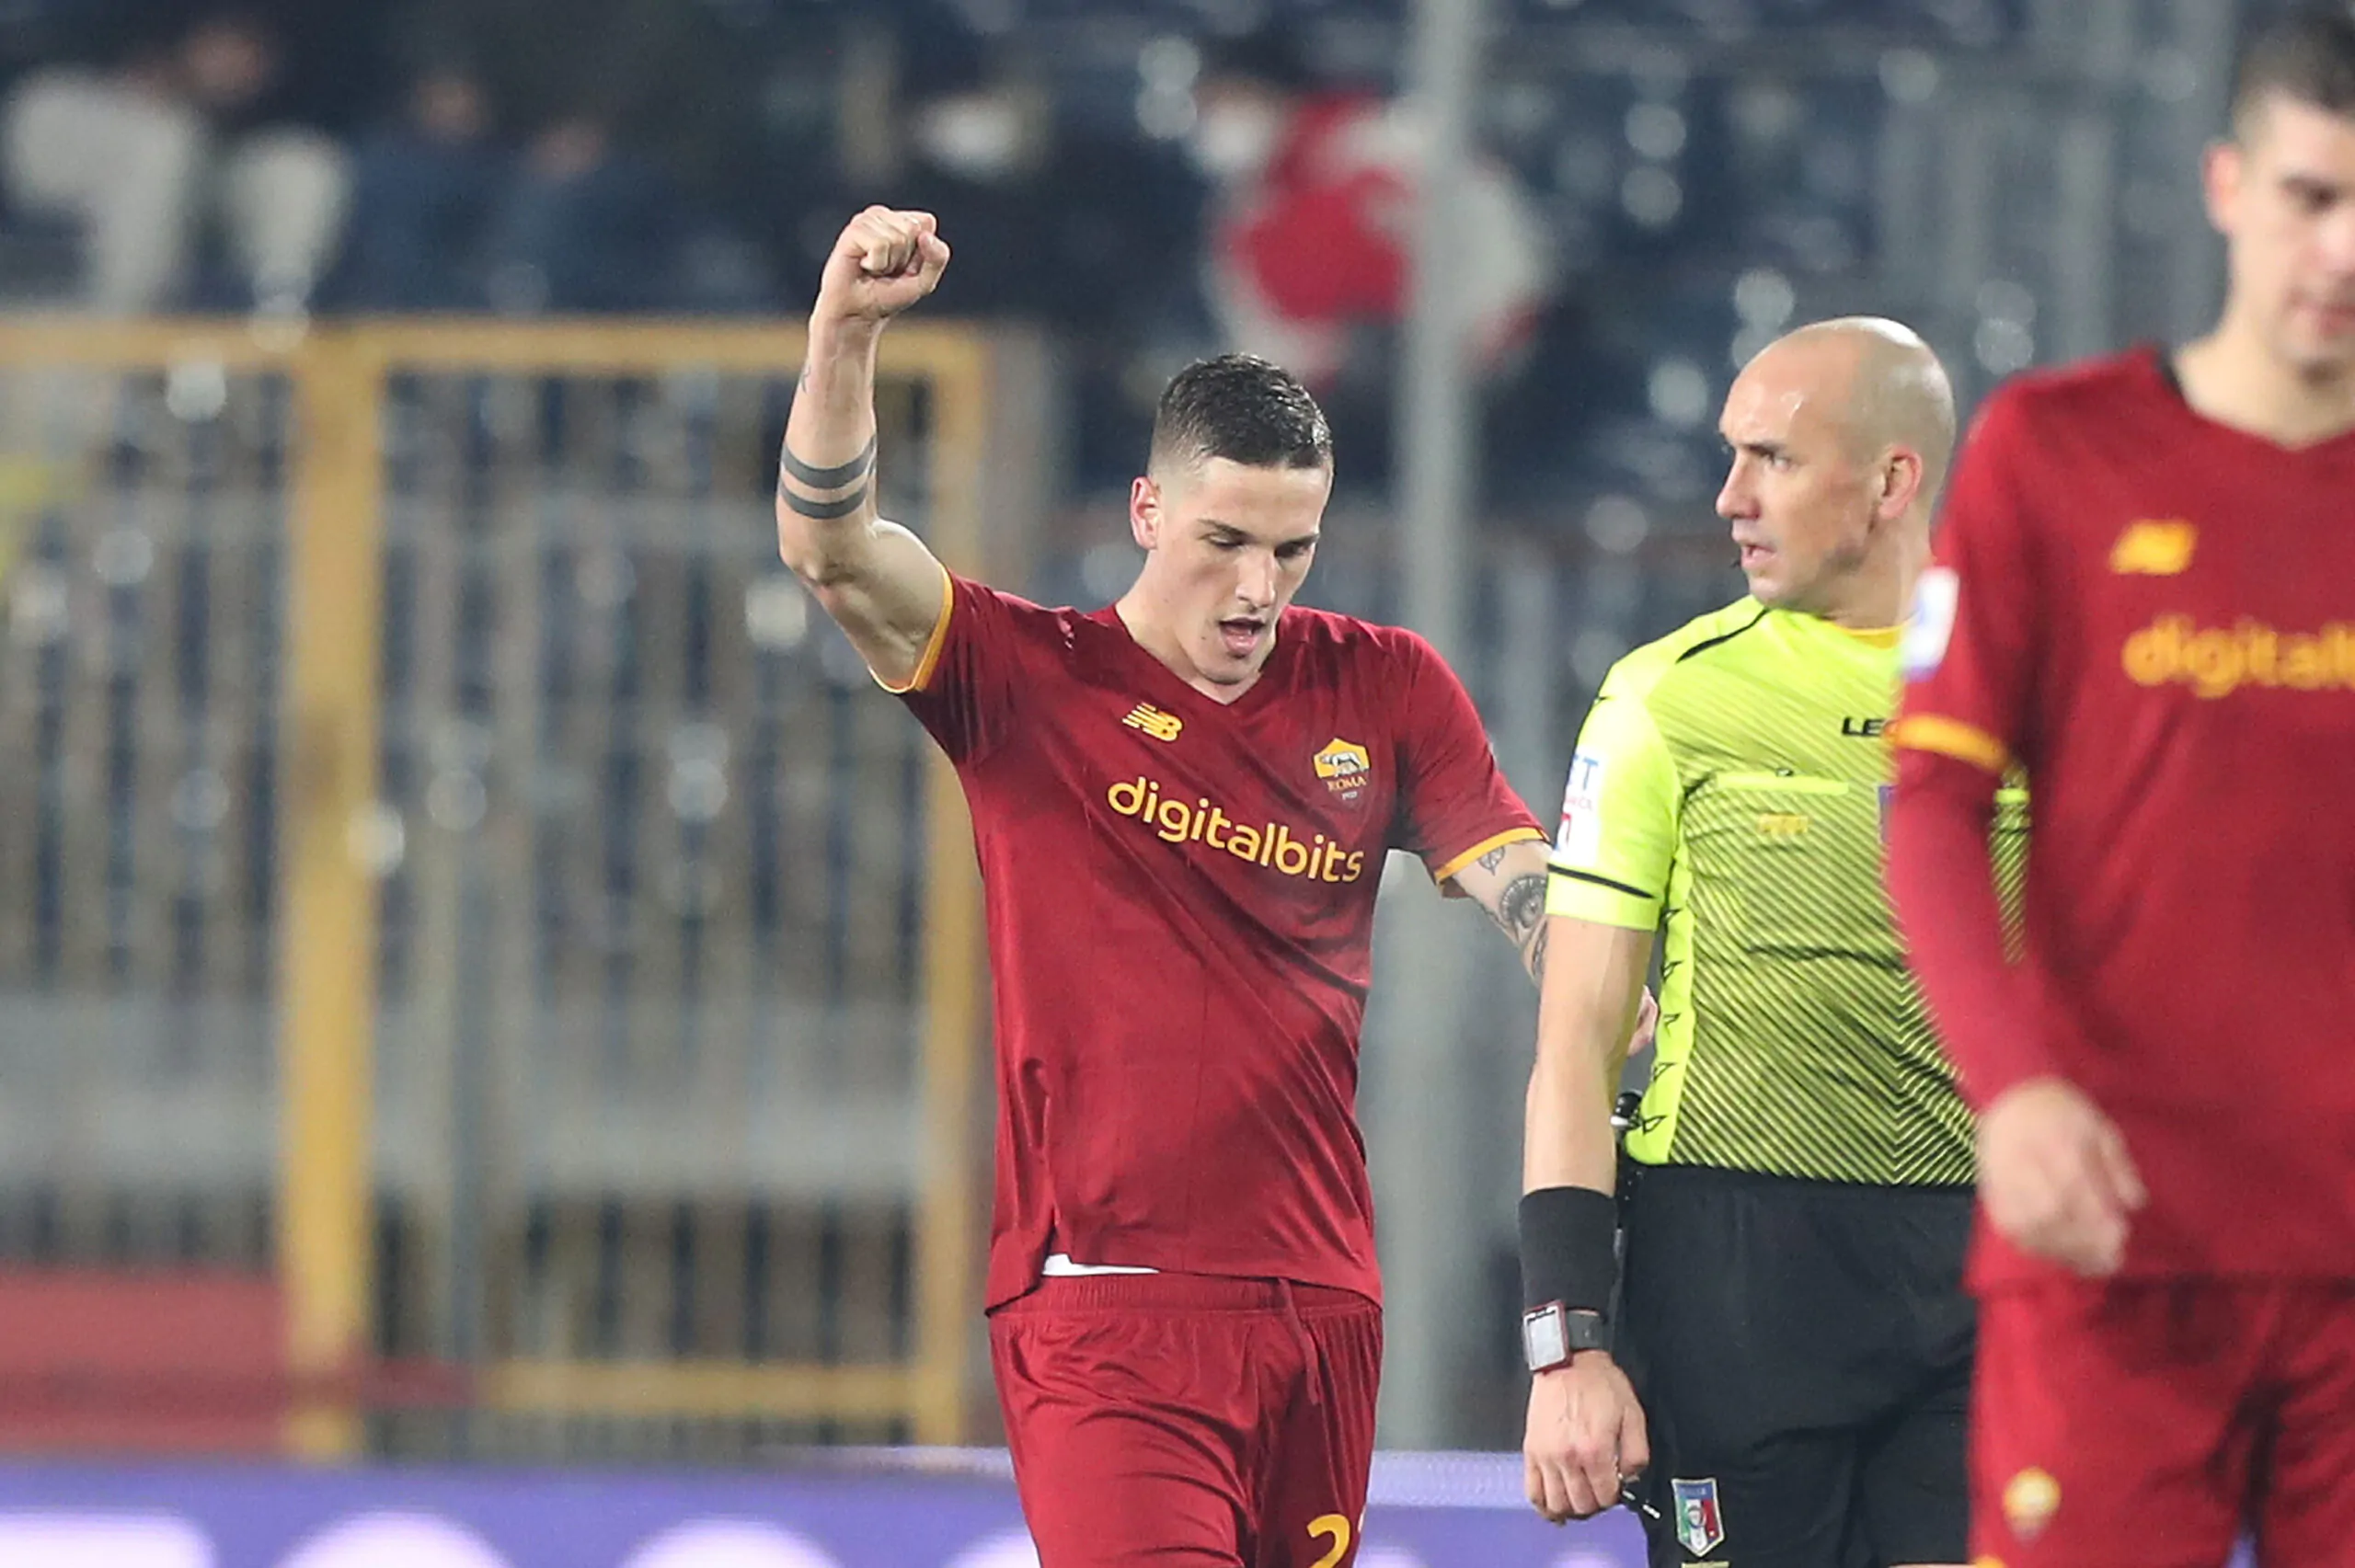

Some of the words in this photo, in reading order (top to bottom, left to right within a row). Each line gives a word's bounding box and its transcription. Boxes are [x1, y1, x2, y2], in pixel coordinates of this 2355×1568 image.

[1842, 716, 1893, 737] LE
[1107, 776, 1365, 883] digitalbits
[1306, 1514, 1364, 1568] 2
